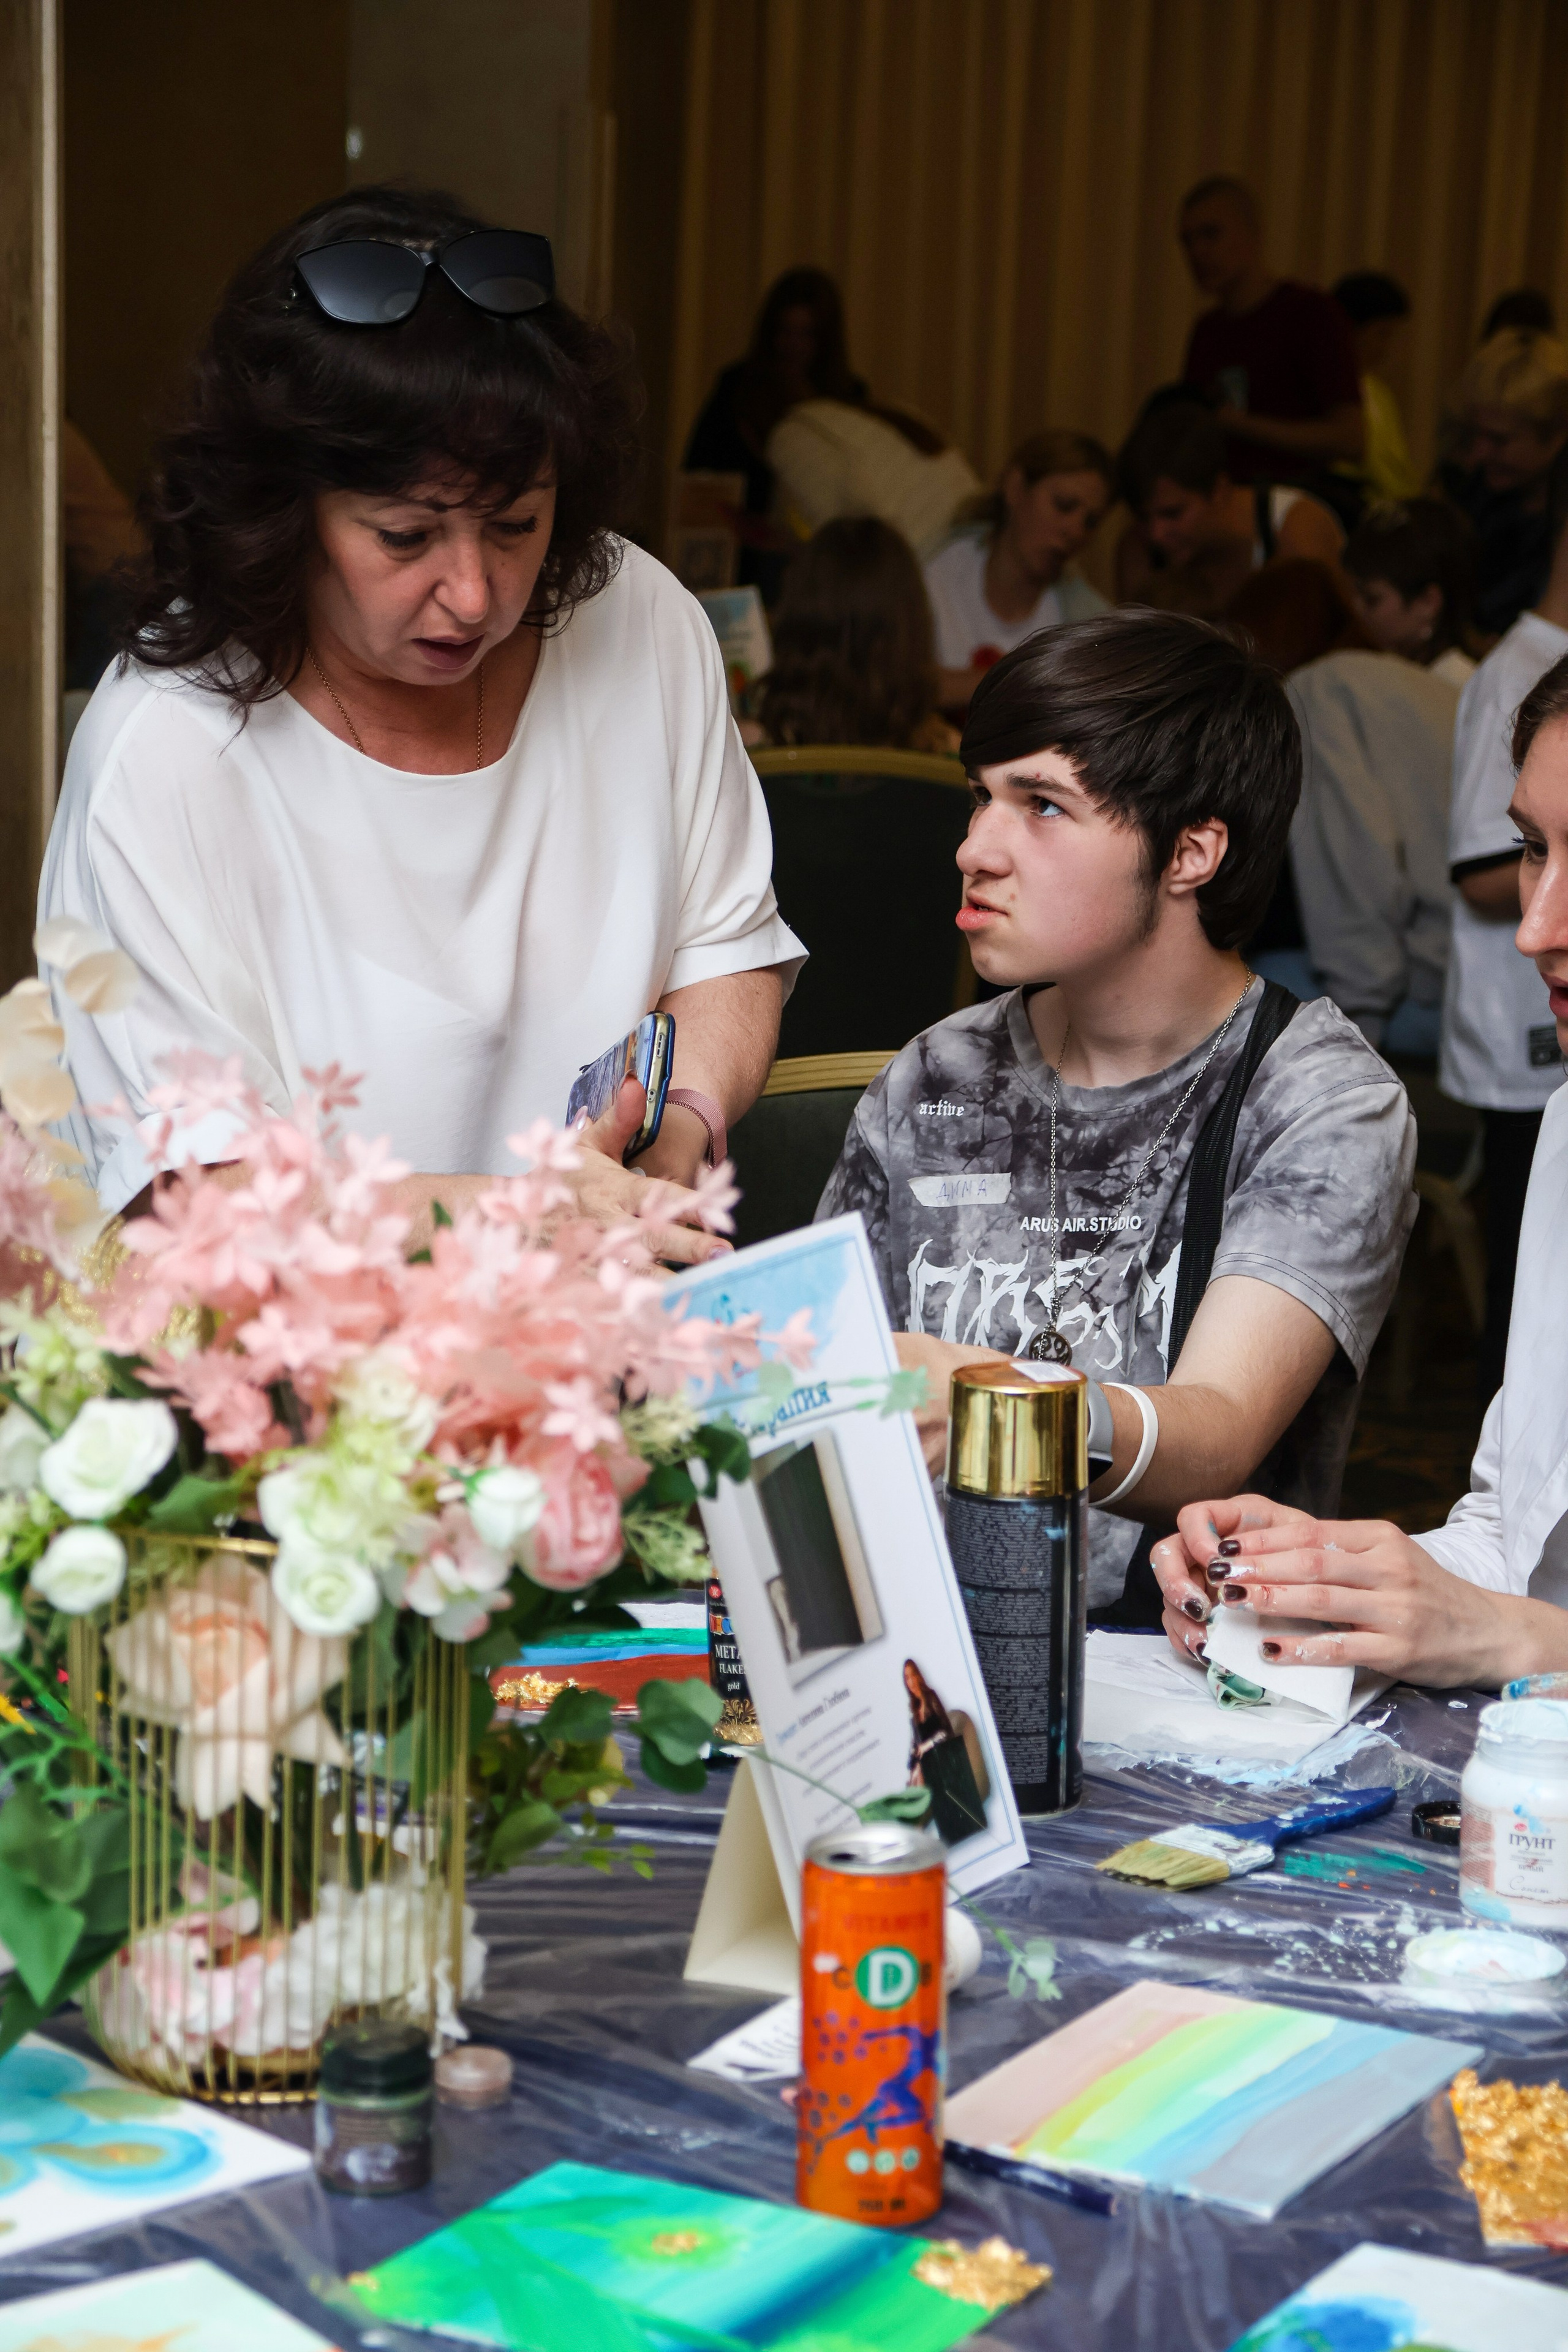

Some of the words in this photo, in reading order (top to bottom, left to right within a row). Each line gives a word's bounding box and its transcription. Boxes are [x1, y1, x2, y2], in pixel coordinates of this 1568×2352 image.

[919, 1099, 965, 1117] active
[937, 1178, 987, 1202] ДИМА
[1019, 1216, 1060, 1232] ARUS
[1061, 1215, 1142, 1232] AIR.STUDIO
[715, 1644, 742, 1660] MET
[719, 1664, 747, 1675] FLAKE
[727, 1682, 740, 1692] gold
[1509, 1833, 1556, 1850] ГРУНТ
